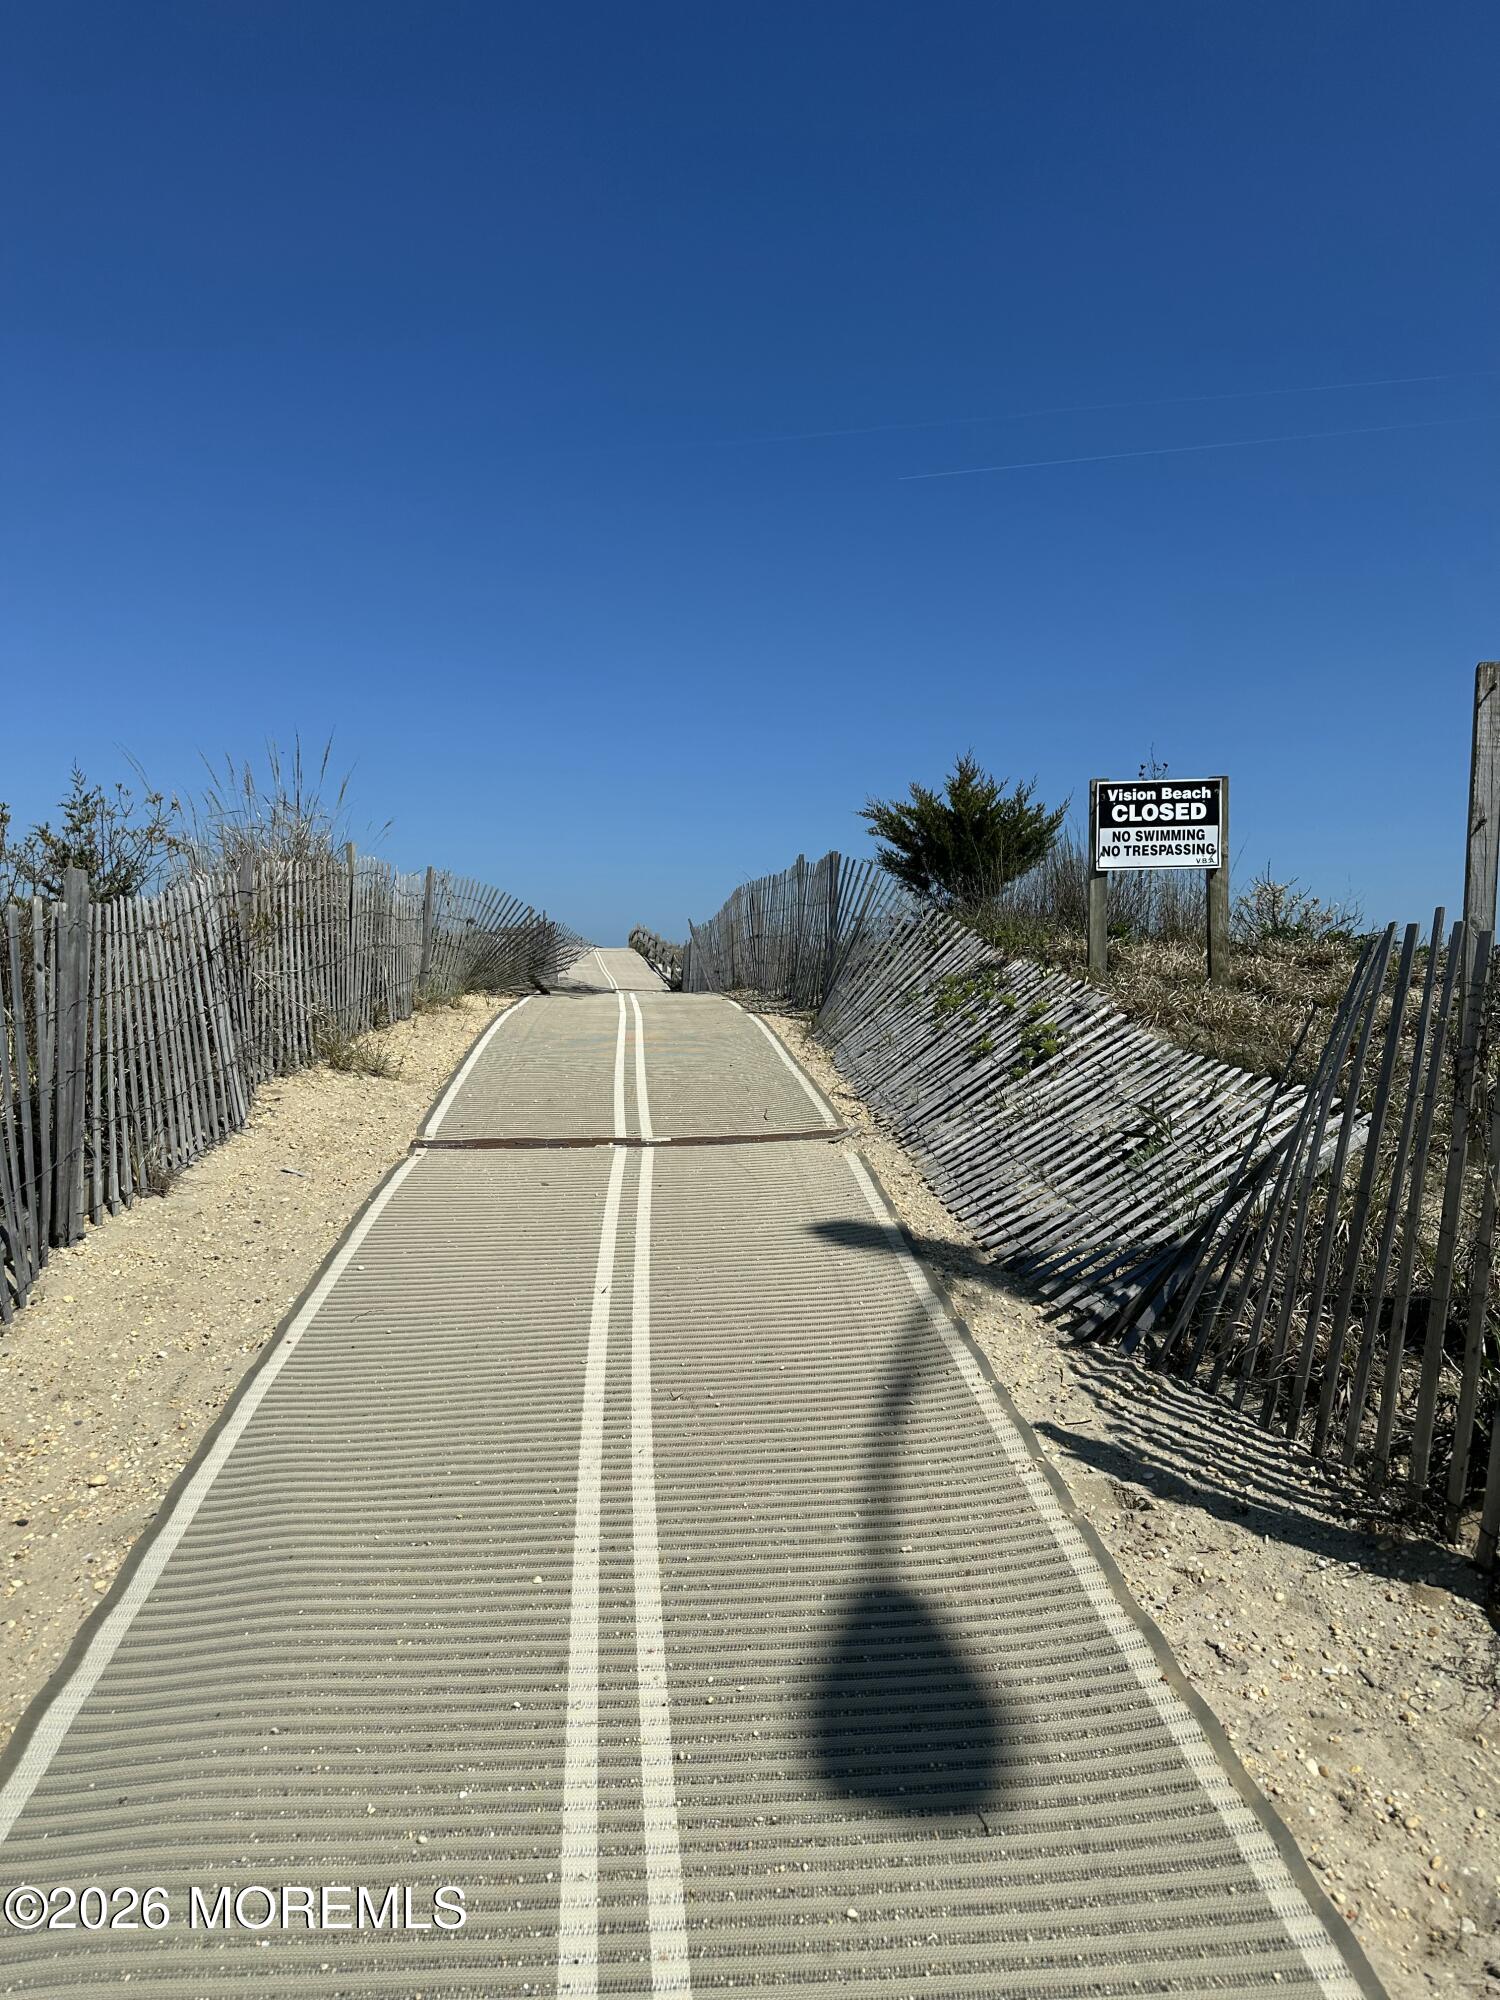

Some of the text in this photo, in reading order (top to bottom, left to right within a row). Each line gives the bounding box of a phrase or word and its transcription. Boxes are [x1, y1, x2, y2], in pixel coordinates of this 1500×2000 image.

[1107, 787, 1211, 801] Vision Beach
[1111, 802, 1207, 822] CLOSED
[1112, 829, 1205, 842] NO SWIMMING
[1101, 843, 1215, 857] NO TRESPASSING
